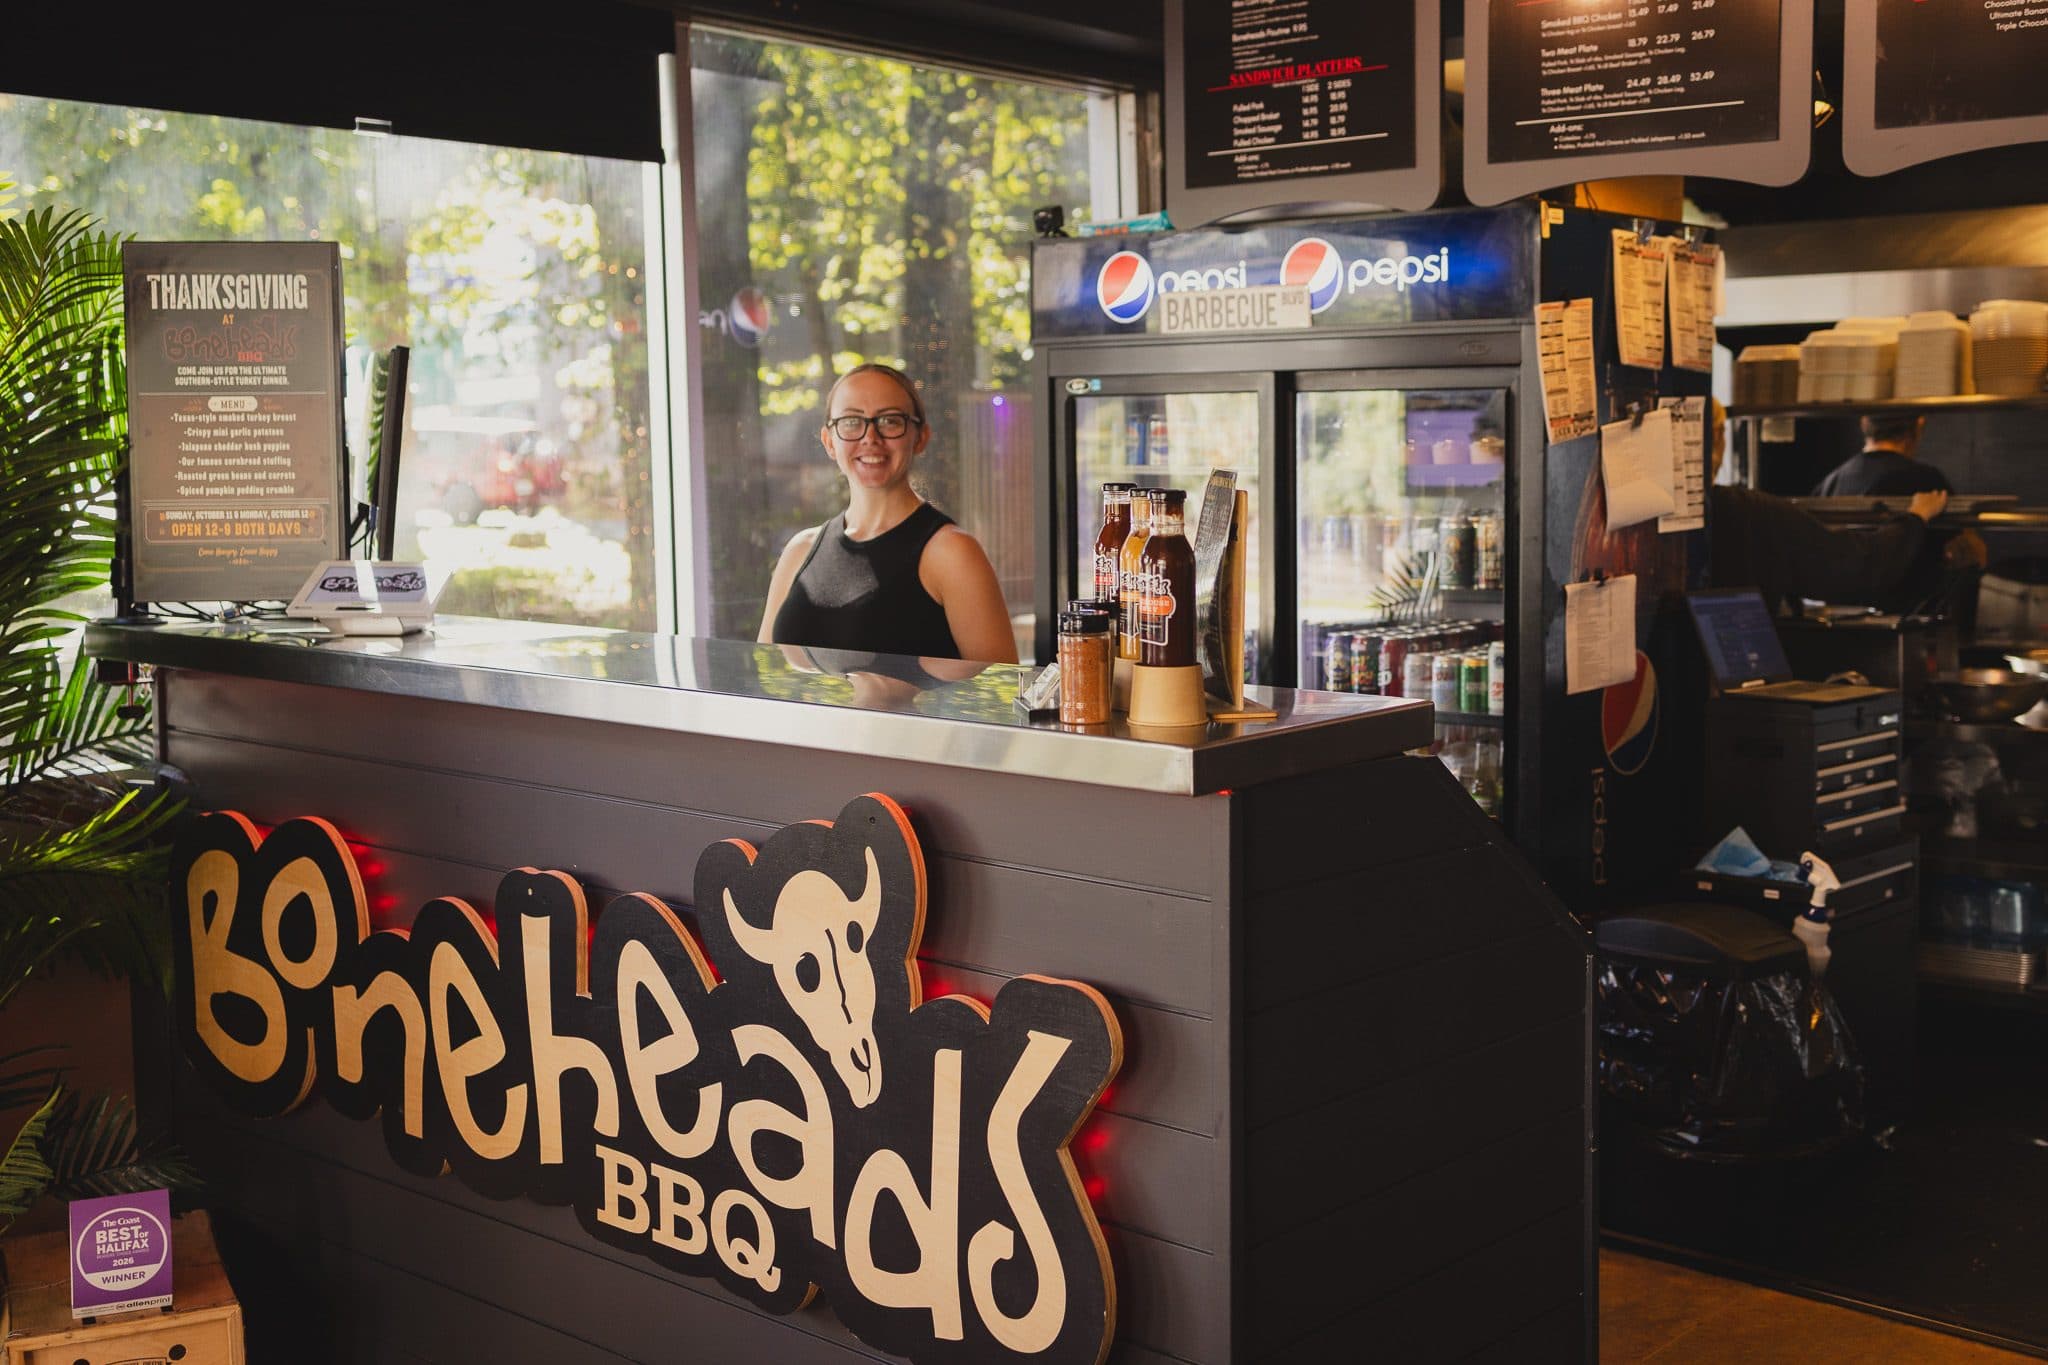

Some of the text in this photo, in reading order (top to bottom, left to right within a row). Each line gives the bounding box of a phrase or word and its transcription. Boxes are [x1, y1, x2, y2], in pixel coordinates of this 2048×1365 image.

[1657, 3, 1679, 14] 17.49
[1996, 21, 2017, 32] Triple
[1557, 46, 1577, 56] Meat
[1578, 44, 1599, 53] Plate
[1656, 33, 1681, 45] 22.79
[1691, 29, 1716, 41] 26.79
[1230, 64, 1295, 84] SANDWICH
[1297, 56, 1362, 78] PLATTERS
[1563, 85, 1583, 95] Meat
[1584, 83, 1604, 92] Plate
[1348, 246, 1449, 295] pepsi
[1157, 260, 1247, 294] pepsi
[147, 273, 308, 310] THANKSGIVING
[1166, 293, 1278, 330] BARBECUE
[222, 313, 235, 326] AT
[238, 366, 252, 376] THE
[253, 366, 287, 376] ULTIMATE
[175, 376, 234, 386] SOUTHERN-STYLE
[235, 376, 261, 386] TURKEY
[220, 400, 246, 409] MENU
[246, 412, 271, 424] turkey
[187, 427, 212, 439] Crispy
[213, 427, 229, 437] mini
[230, 427, 252, 439] garlic
[214, 442, 243, 452] cheddar
[263, 441, 291, 452] puppies
[182, 457, 196, 466] Our
[262, 456, 291, 467] stuffing
[165, 511, 195, 522] SUNDAY,
[196, 510, 225, 520] OCTOBER
[239, 510, 270, 521] MONDAY,
[271, 510, 300, 520] OCTOBER
[171, 522, 202, 536] OPEN
[234, 522, 265, 536] BOTH
[268, 522, 301, 536] DAYS
[187, 849, 1072, 1354] Boneheads
[102, 1216, 141, 1228] The Coast
[594, 1144, 781, 1293] BBQ
[95, 1225, 149, 1244] BEST OF
[96, 1238, 149, 1255] HALIFAX
[112, 1257, 135, 1267] 2026
[101, 1271, 146, 1285] WINNER
